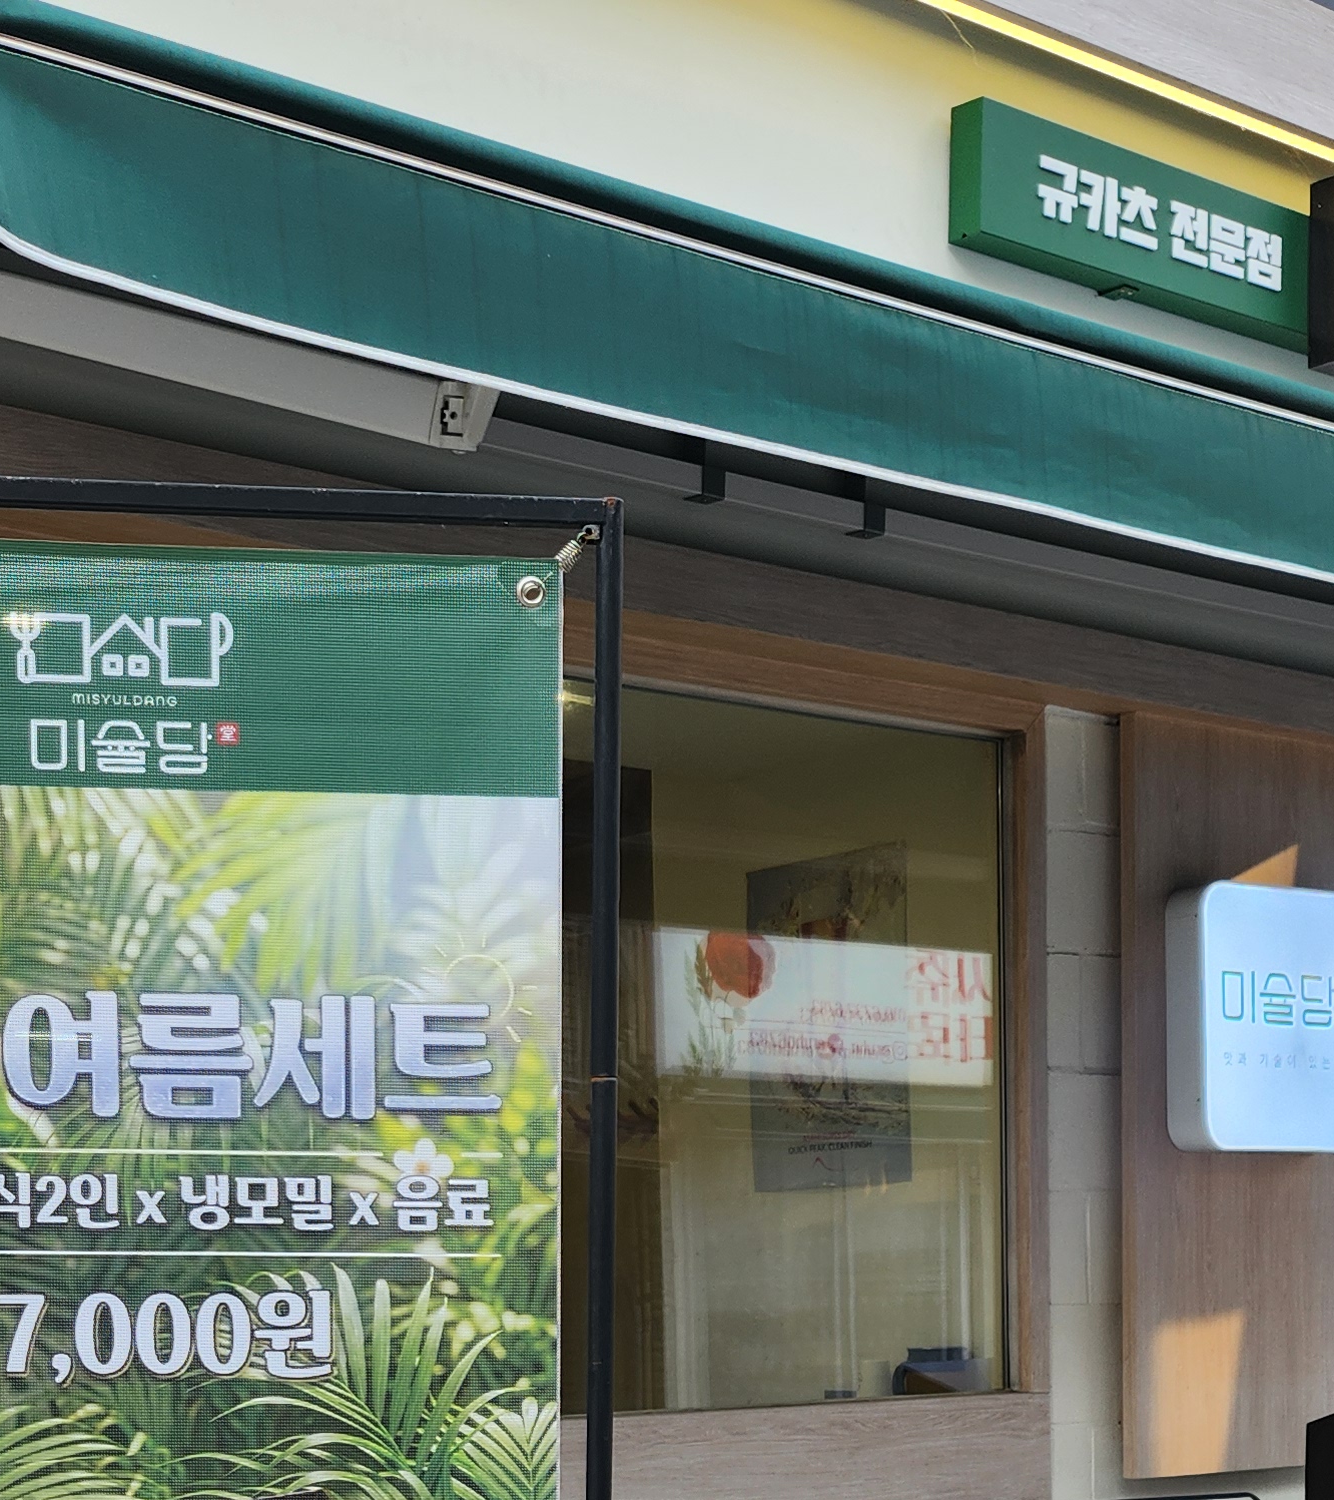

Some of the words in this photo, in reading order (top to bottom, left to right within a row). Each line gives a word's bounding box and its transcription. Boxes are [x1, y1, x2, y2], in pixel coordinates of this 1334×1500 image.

[1037, 154, 1159, 251] 규카츠
[1170, 200, 1283, 292] 전문점
[72, 692, 178, 707] MISYULDANG
[29, 719, 213, 775] 미슐당
[0, 989, 503, 1122] 여름세트
[179, 1172, 334, 1232] 냉모밀
[393, 1172, 495, 1232] 음료
